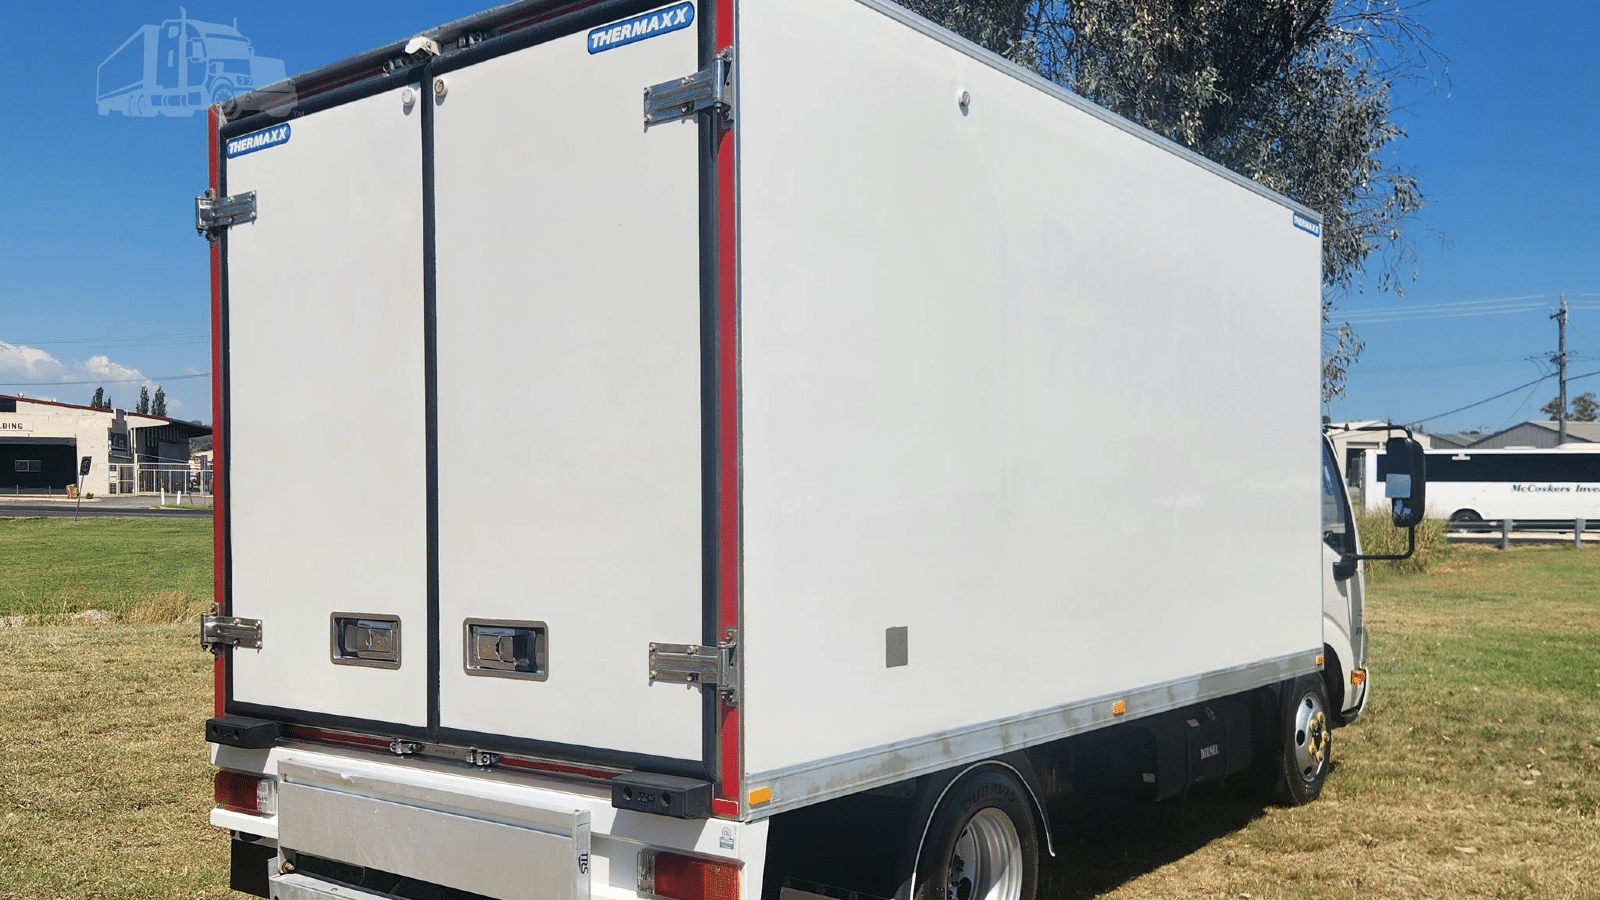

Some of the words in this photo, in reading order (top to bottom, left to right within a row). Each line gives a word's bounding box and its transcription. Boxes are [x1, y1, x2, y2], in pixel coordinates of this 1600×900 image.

[591, 6, 689, 49] THERMAXX
[228, 126, 289, 154] THERMAXX
[0, 422, 23, 430] DING
[1512, 484, 1571, 493] McCoskers
[1200, 743, 1220, 760] DIESEL
